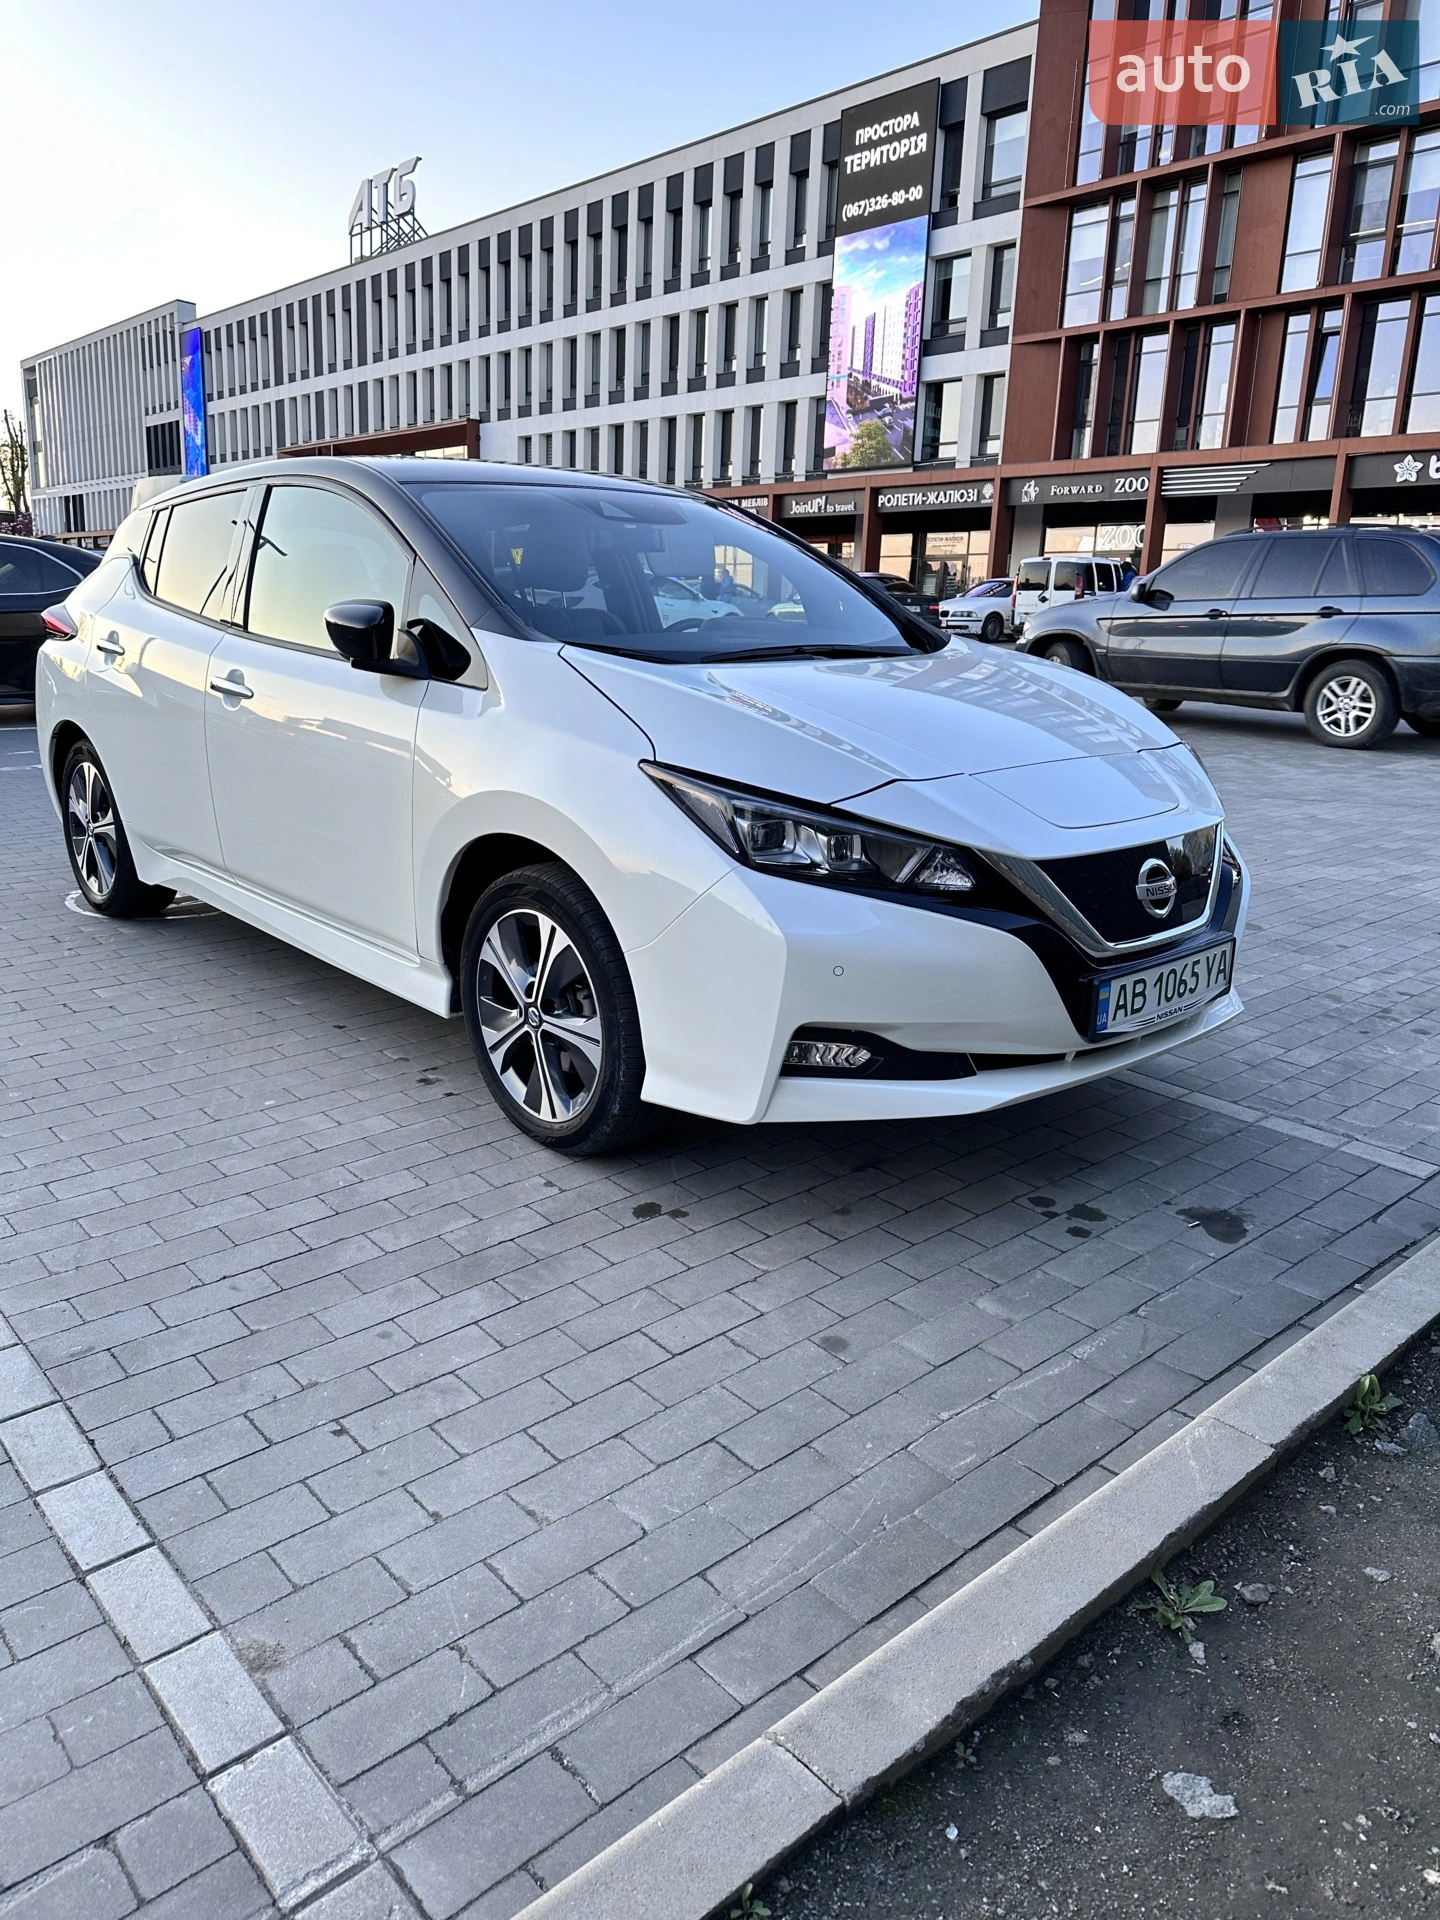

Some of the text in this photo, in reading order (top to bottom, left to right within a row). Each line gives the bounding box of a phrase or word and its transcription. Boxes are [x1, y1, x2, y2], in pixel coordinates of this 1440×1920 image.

[855, 111, 920, 146] ПРОСТОРА
[844, 132, 928, 175] ТЕРИТОРІЯ
[348, 156, 422, 235] АТБ
[842, 184, 923, 222] (067)326-80-00
[1050, 476, 1149, 496] FORWARD ZOO
[741, 497, 768, 508] МЕБЛІВ
[826, 503, 834, 512] to
[835, 501, 855, 512] travel
[878, 488, 978, 508] РОЛЕТИ-ЖАЛЮЗІ
[1111, 948, 1227, 1021] AB 1065 YA
[1097, 1011, 1107, 1026] UA
[1156, 1006, 1184, 1021] NISSAN
